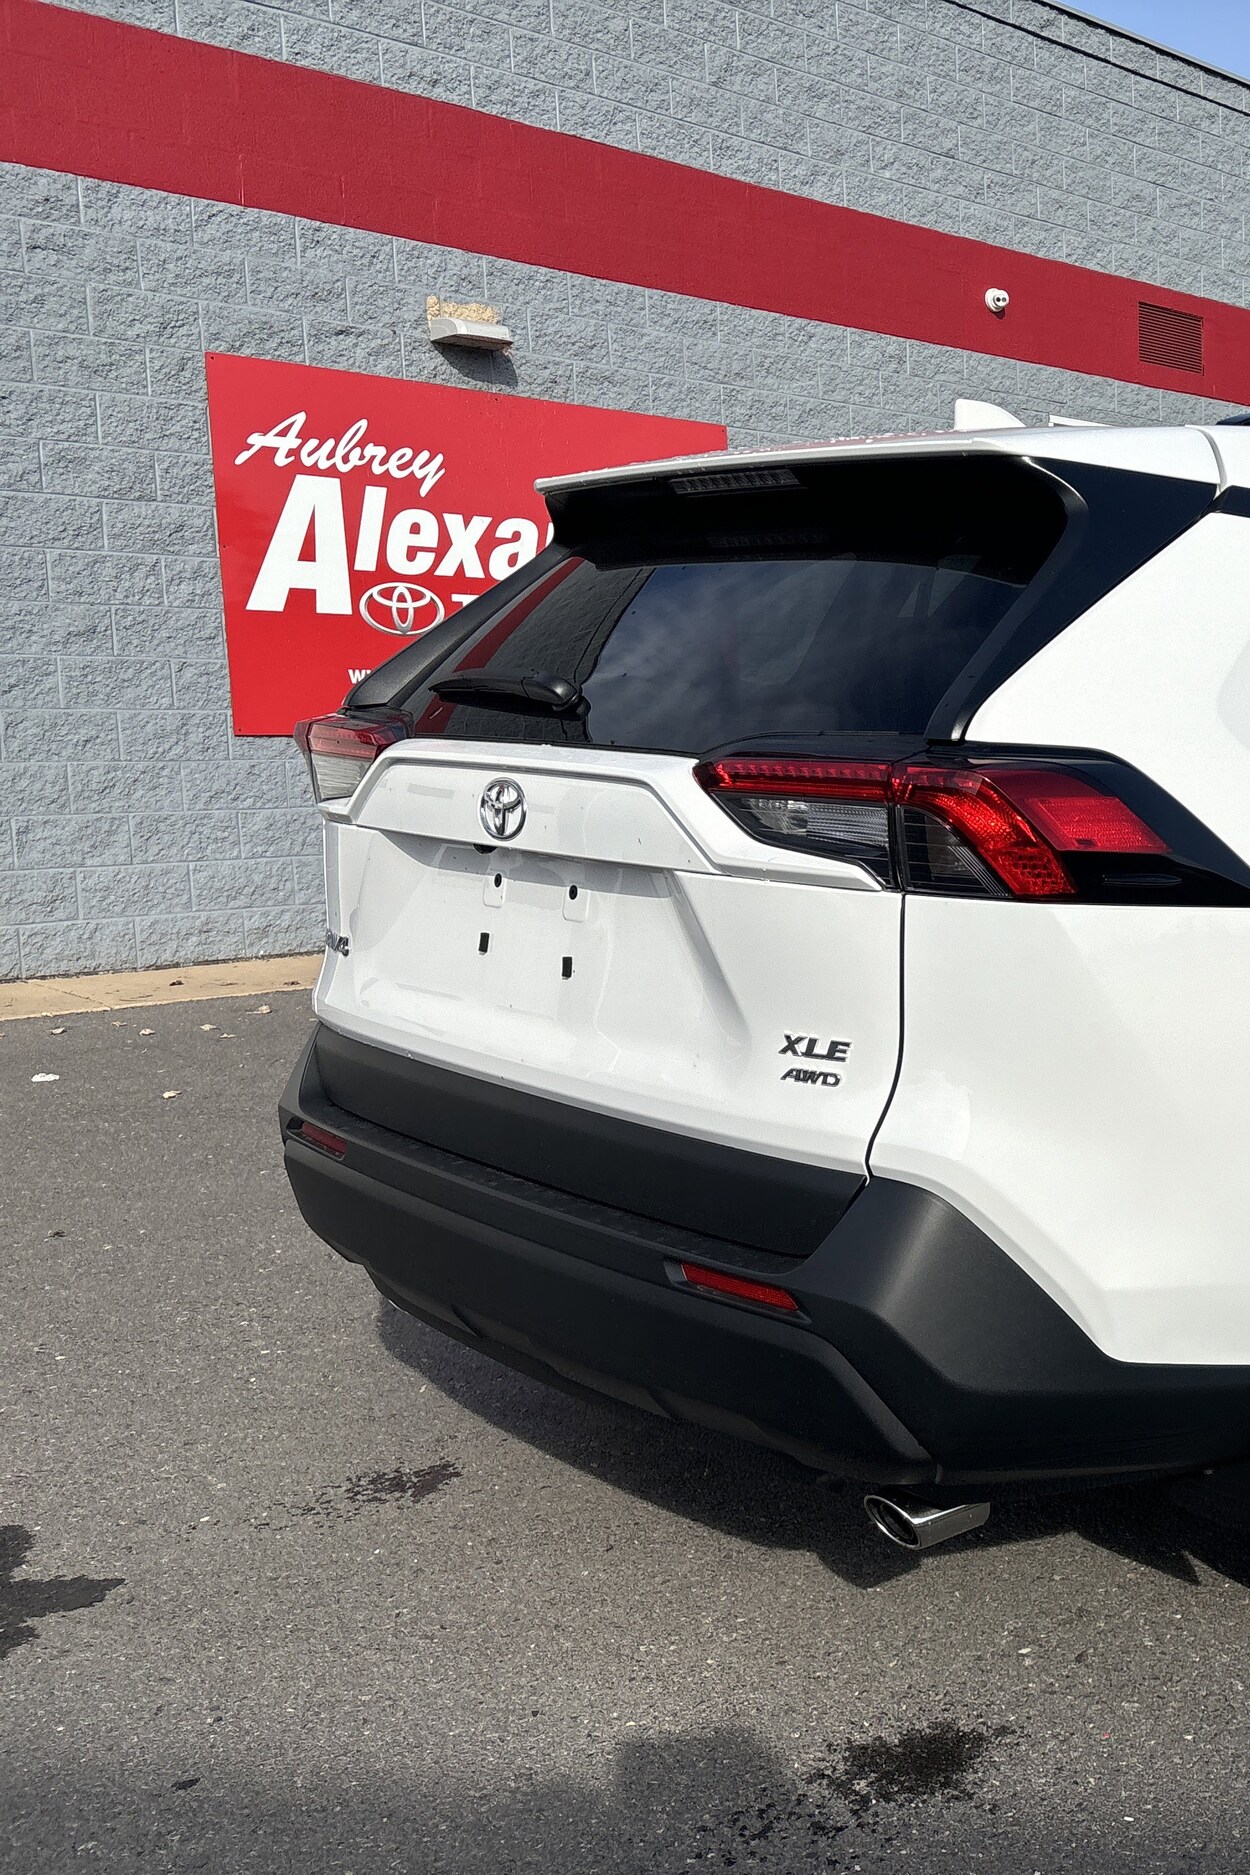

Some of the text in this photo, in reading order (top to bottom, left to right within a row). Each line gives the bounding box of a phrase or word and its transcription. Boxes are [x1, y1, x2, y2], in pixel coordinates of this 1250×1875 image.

[233, 410, 446, 498] Aubrey
[244, 473, 555, 616] Alexa
[778, 1032, 852, 1062] XLE
[780, 1067, 842, 1088] AWD
